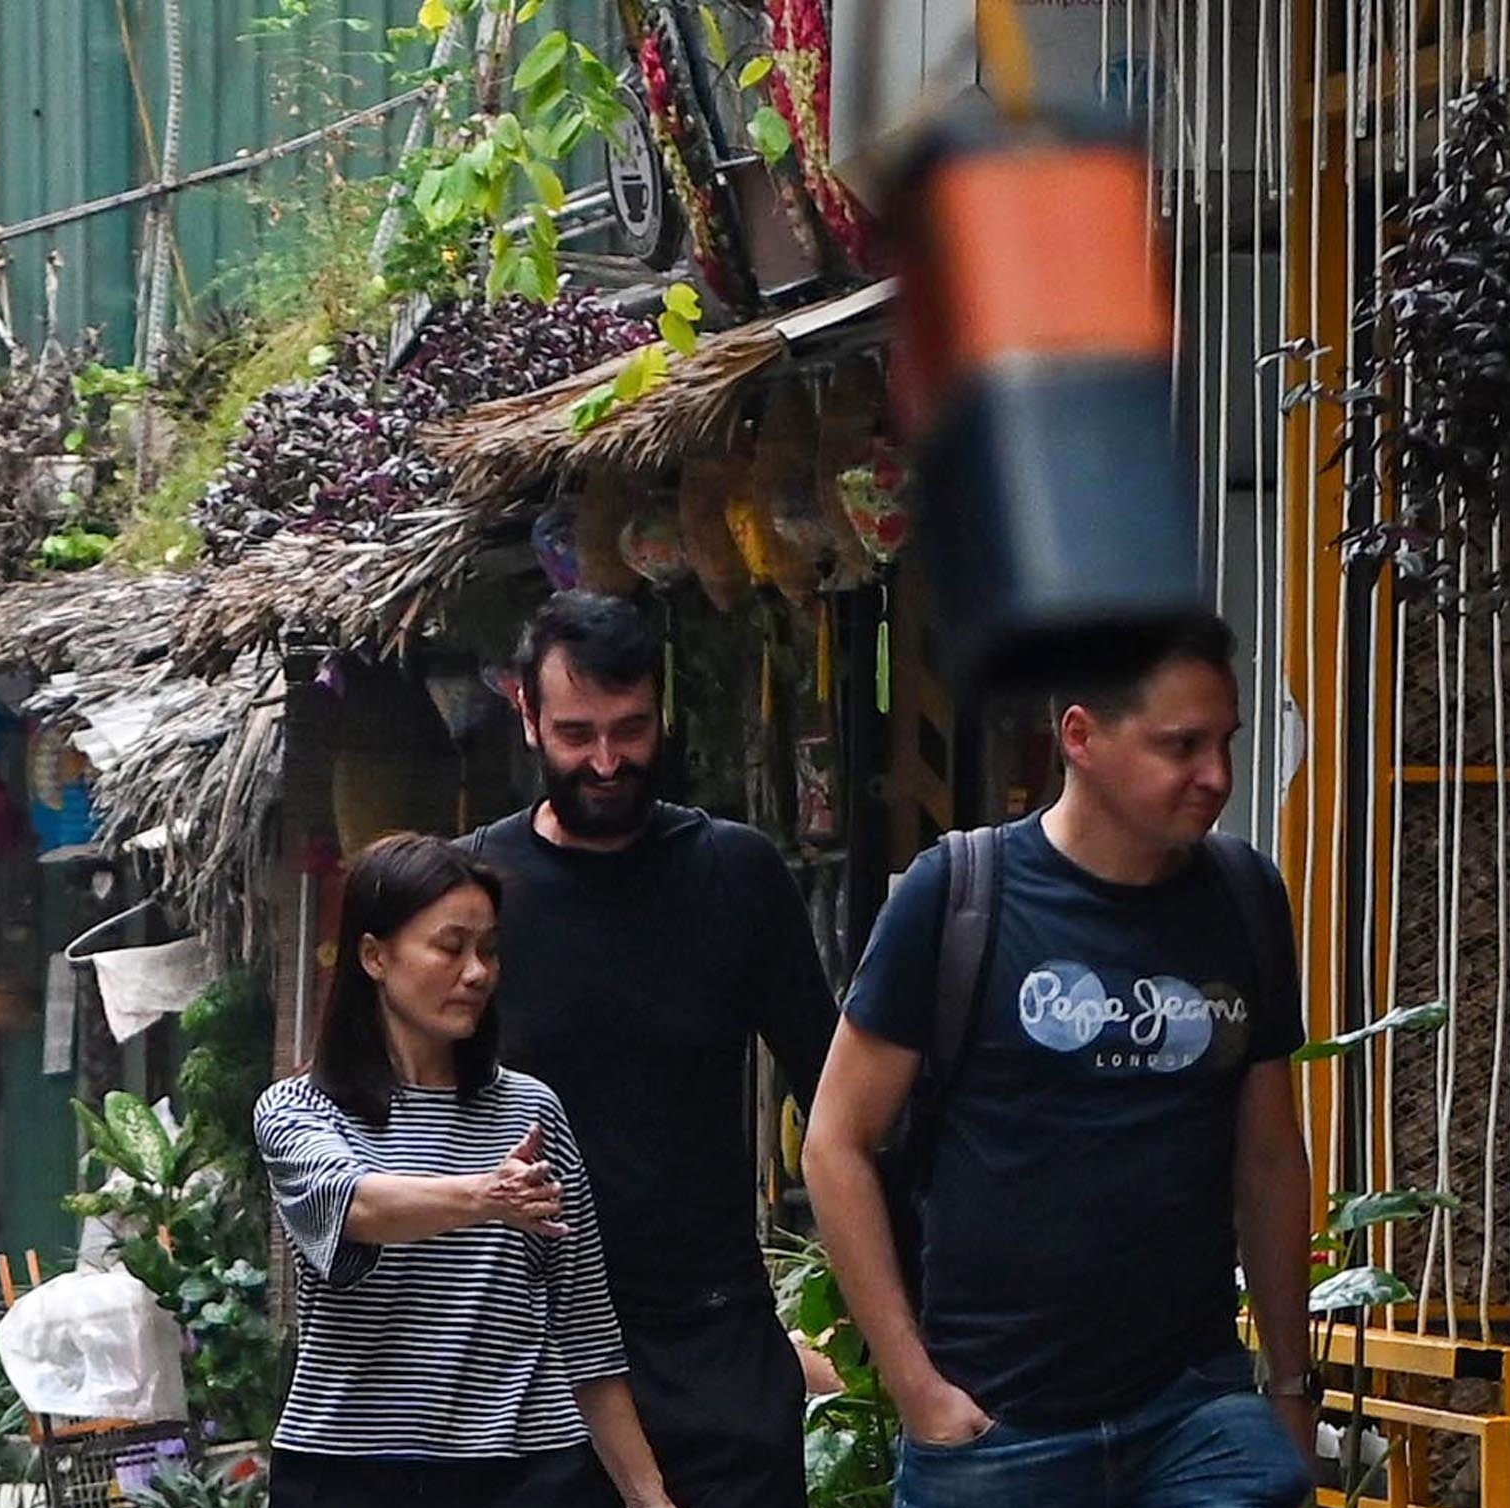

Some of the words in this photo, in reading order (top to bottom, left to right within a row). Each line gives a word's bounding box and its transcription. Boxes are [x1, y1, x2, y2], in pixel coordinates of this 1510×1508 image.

[1019, 971, 1129, 1043] Pepe
[1131, 978, 1248, 1046] Jeans
[1095, 1053, 1195, 1068] LONDON
